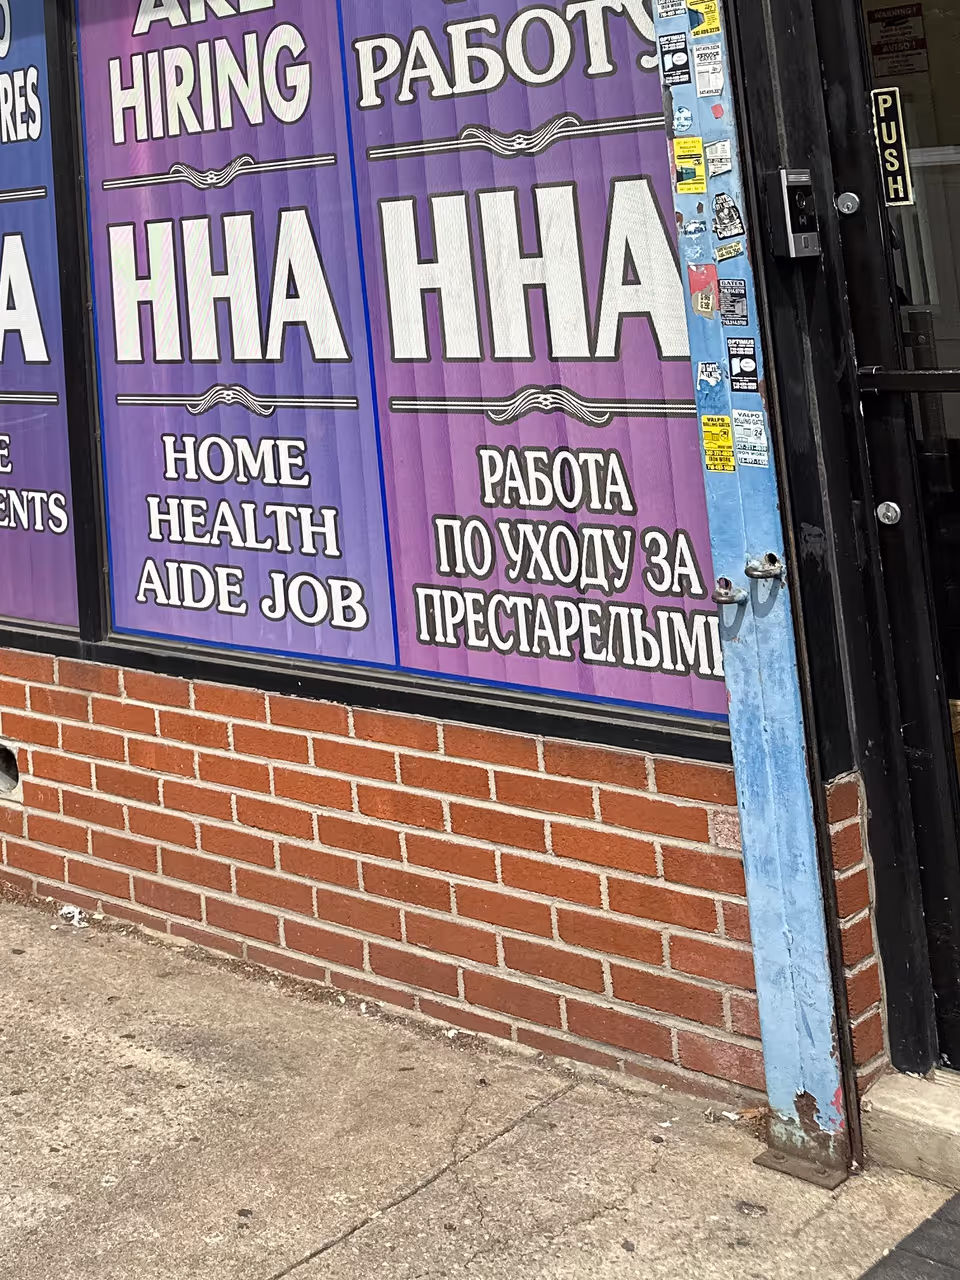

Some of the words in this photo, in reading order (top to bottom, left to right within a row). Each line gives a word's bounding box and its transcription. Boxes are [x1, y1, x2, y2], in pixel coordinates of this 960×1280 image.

[659, 33, 686, 42] OPTIMUS
[108, 23, 311, 145] HIRING
[878, 93, 905, 199] PUSH
[106, 206, 352, 363] HHA
[727, 338, 755, 346] OPTIMUS
[161, 433, 310, 486] HOME
[479, 448, 634, 513] РАБОТА
[145, 495, 343, 558] HEALTH
[435, 516, 492, 577] ПО
[499, 519, 633, 593] УХОДУ
[642, 529, 704, 596] ЗА
[136, 557, 248, 615] AIDE
[259, 570, 369, 631] JOB
